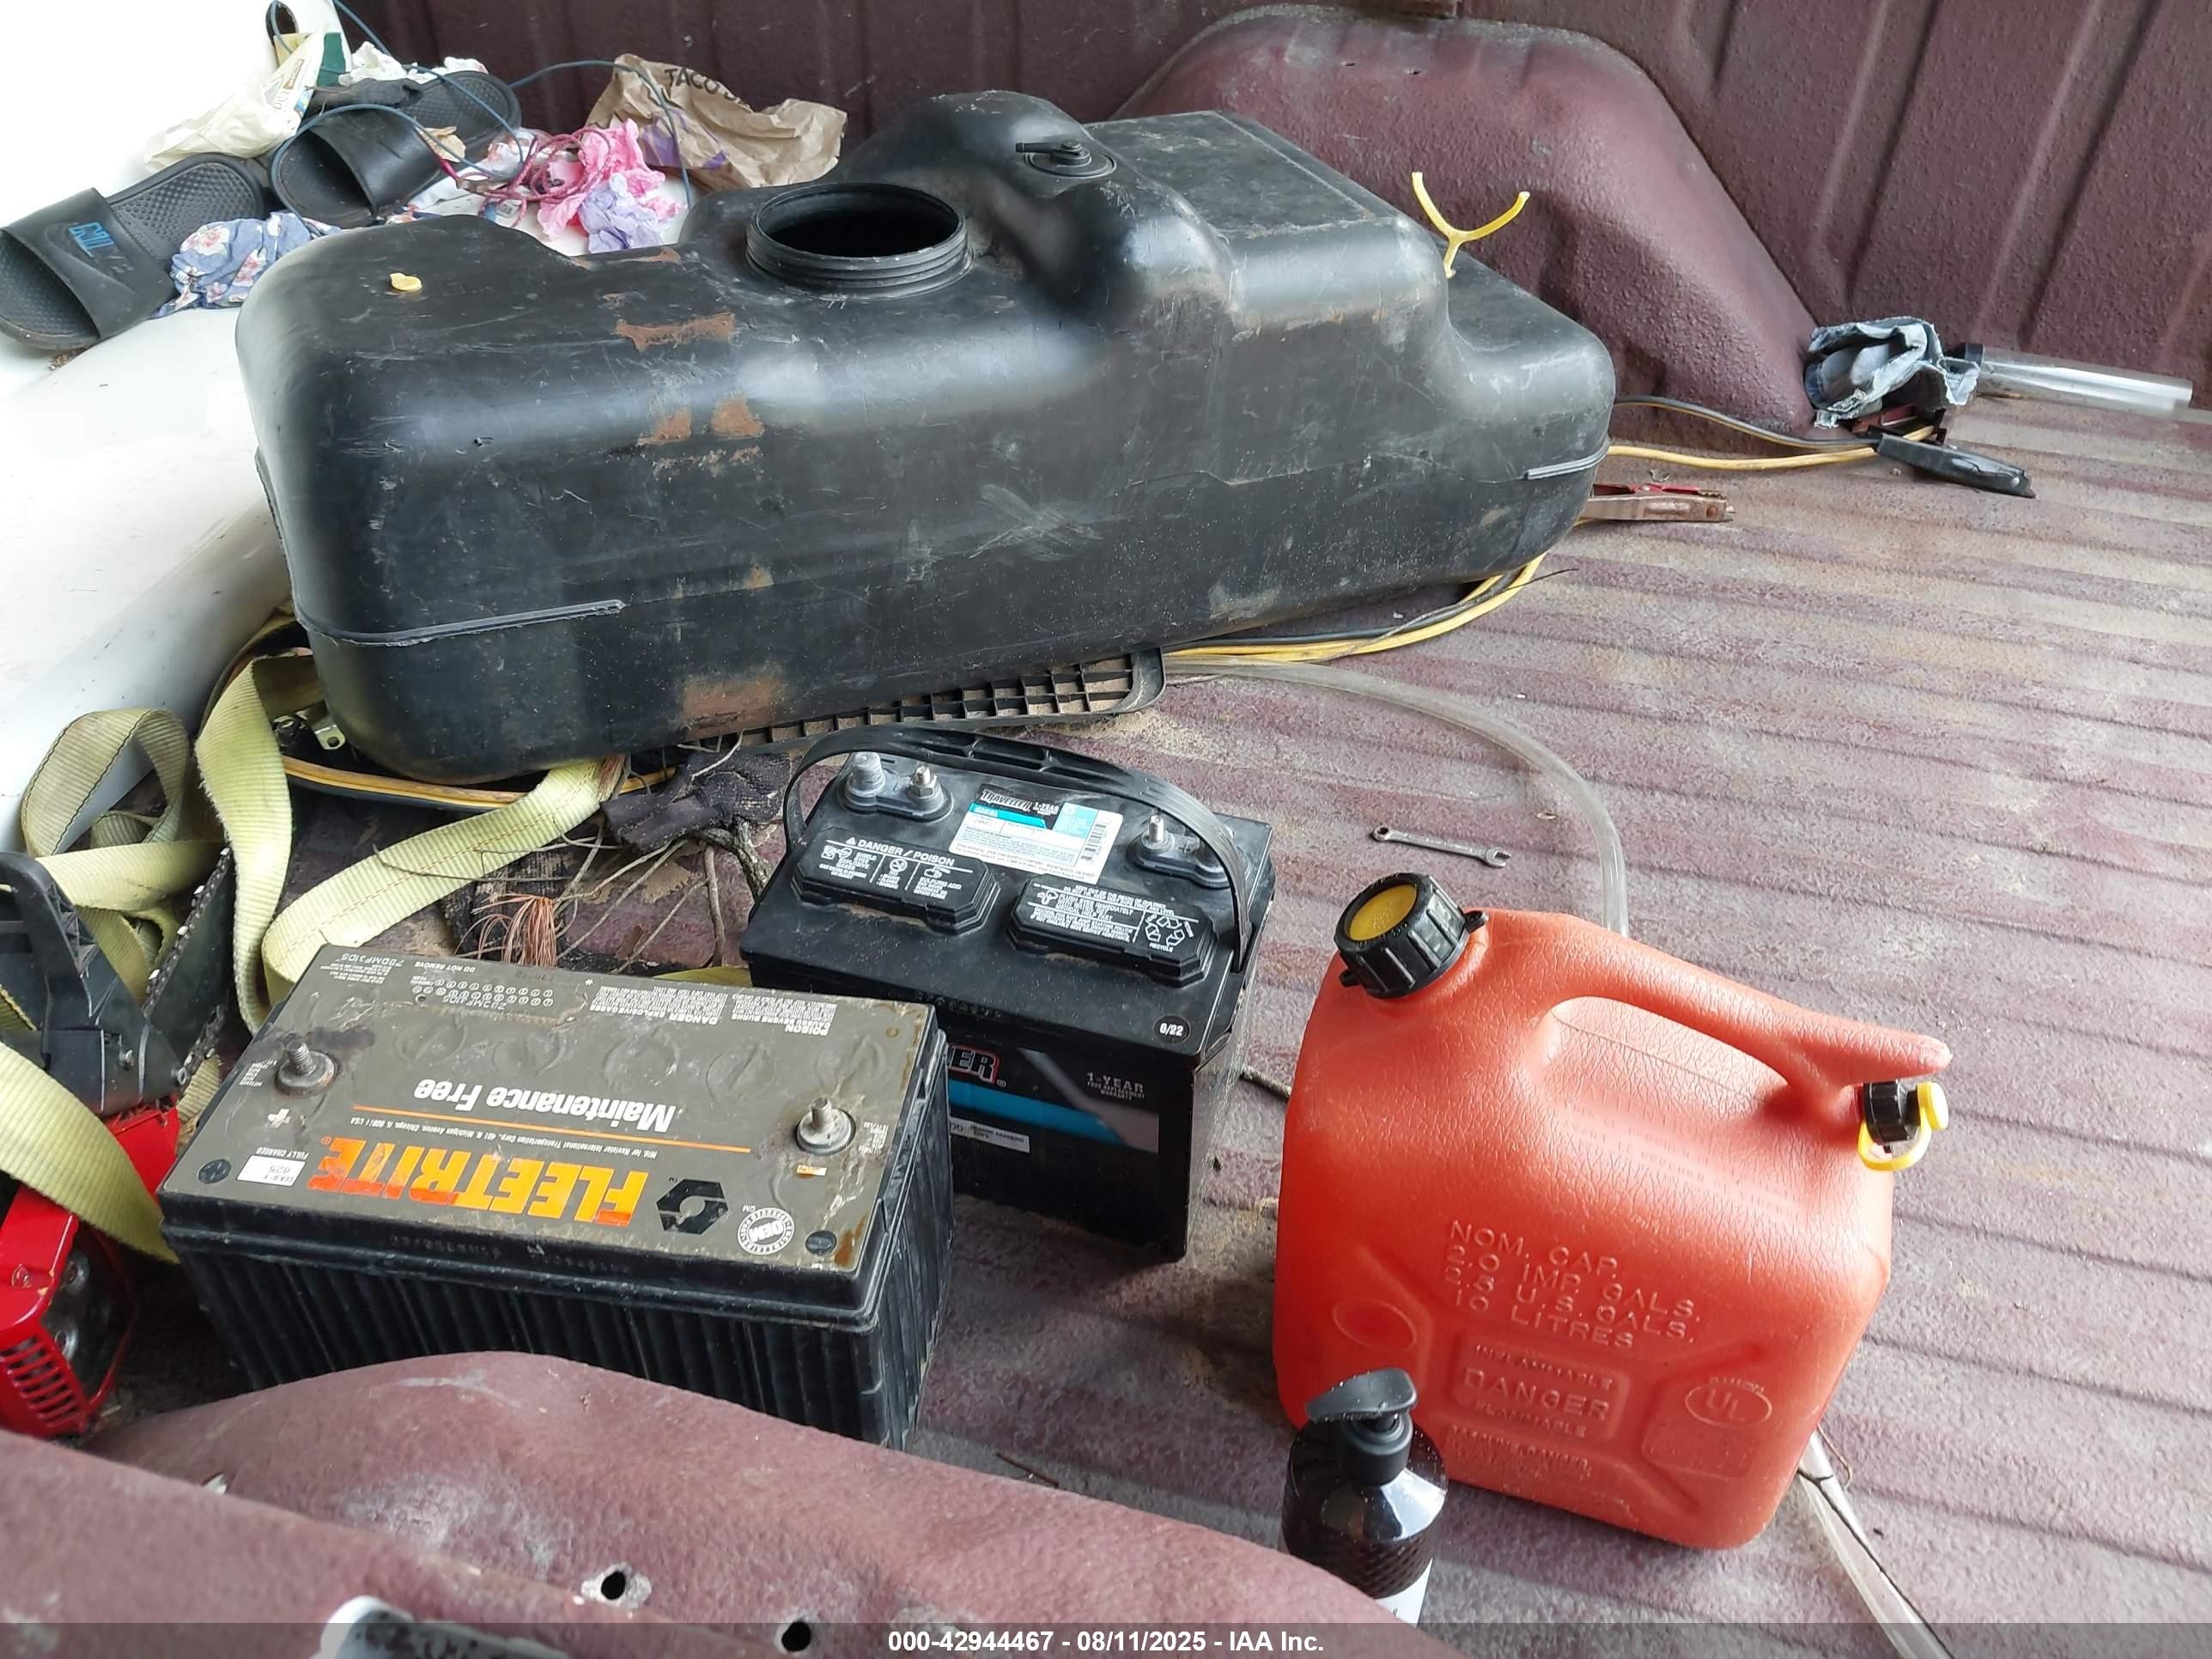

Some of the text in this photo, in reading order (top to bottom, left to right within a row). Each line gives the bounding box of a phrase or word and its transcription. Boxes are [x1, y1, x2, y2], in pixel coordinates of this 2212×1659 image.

[664, 68, 721, 95] TACO
[857, 839, 903, 856] DANGER
[913, 851, 955, 866] POISON
[414, 960, 447, 971] REMOVE
[669, 1012, 719, 1025] DANGER
[784, 1024, 830, 1036] POISON
[413, 1079, 676, 1132] Maintenance Free
[256, 1146, 310, 1160] FULLY CHARGED
[307, 1139, 648, 1225] FLEETRITE
[748, 1219, 784, 1243] OEM
[1449, 1219, 1620, 1279] NOM. CAP.
[1455, 1288, 1635, 1348] 10 LITRES
[1516, 1285, 1584, 1320] U.S.
[1596, 1304, 1695, 1345] GALS.
[1601, 1283, 1701, 1323] GALS.
[1463, 1365, 1611, 1423] DANGER
[1705, 1387, 1744, 1424] UL
